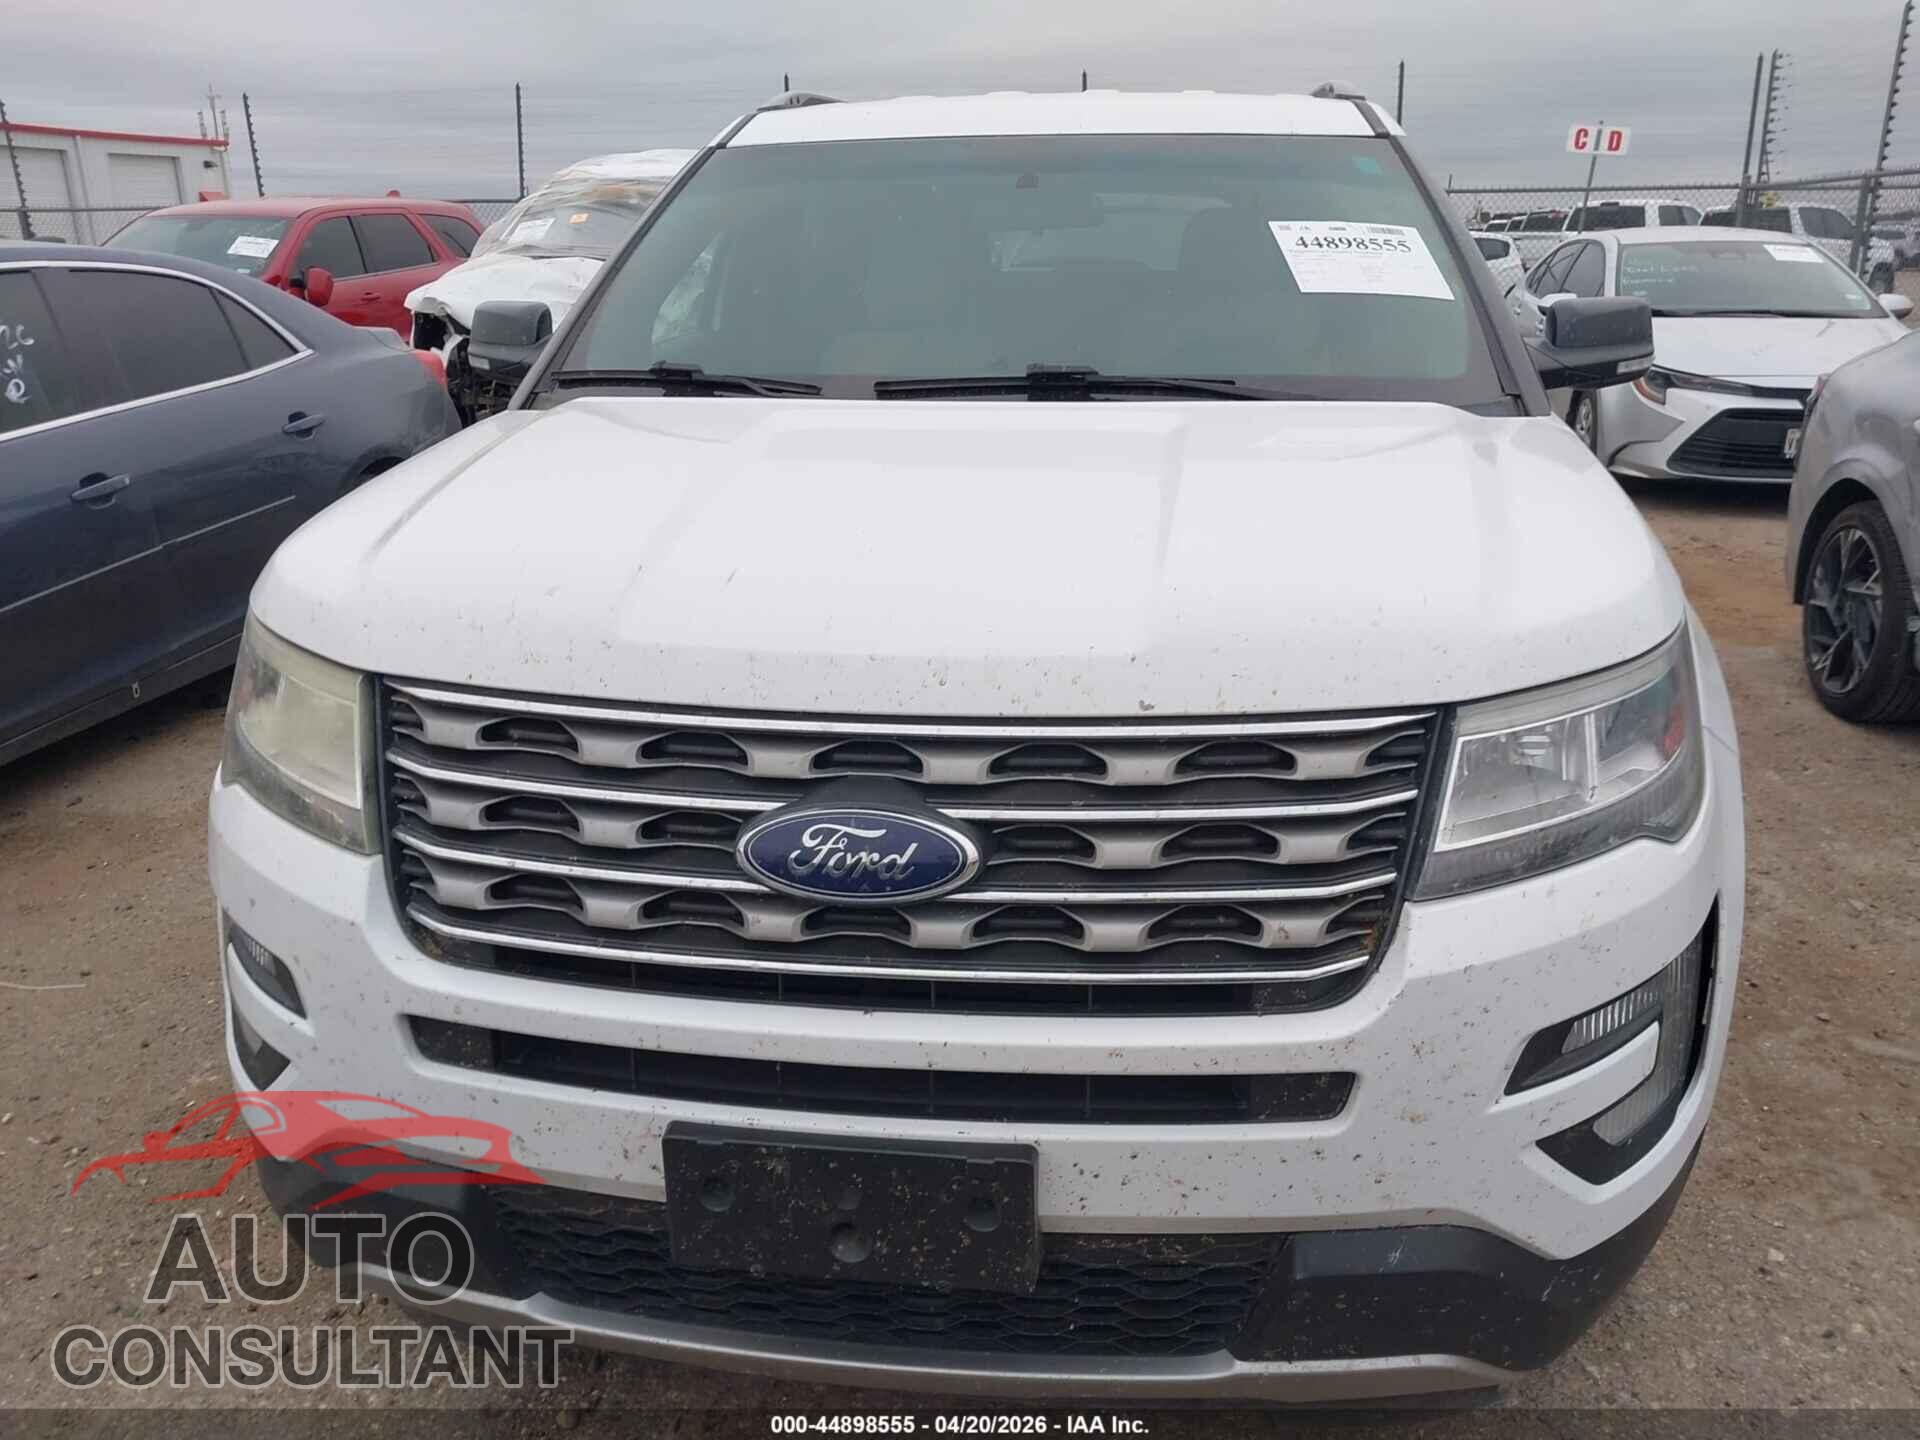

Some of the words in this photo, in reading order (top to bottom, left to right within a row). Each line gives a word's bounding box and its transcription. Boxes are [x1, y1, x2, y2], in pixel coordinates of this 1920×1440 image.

[1574, 128, 1589, 150] C
[1607, 130, 1623, 151] D
[1295, 235, 1412, 254] 44898555
[788, 823, 919, 881] Ford
